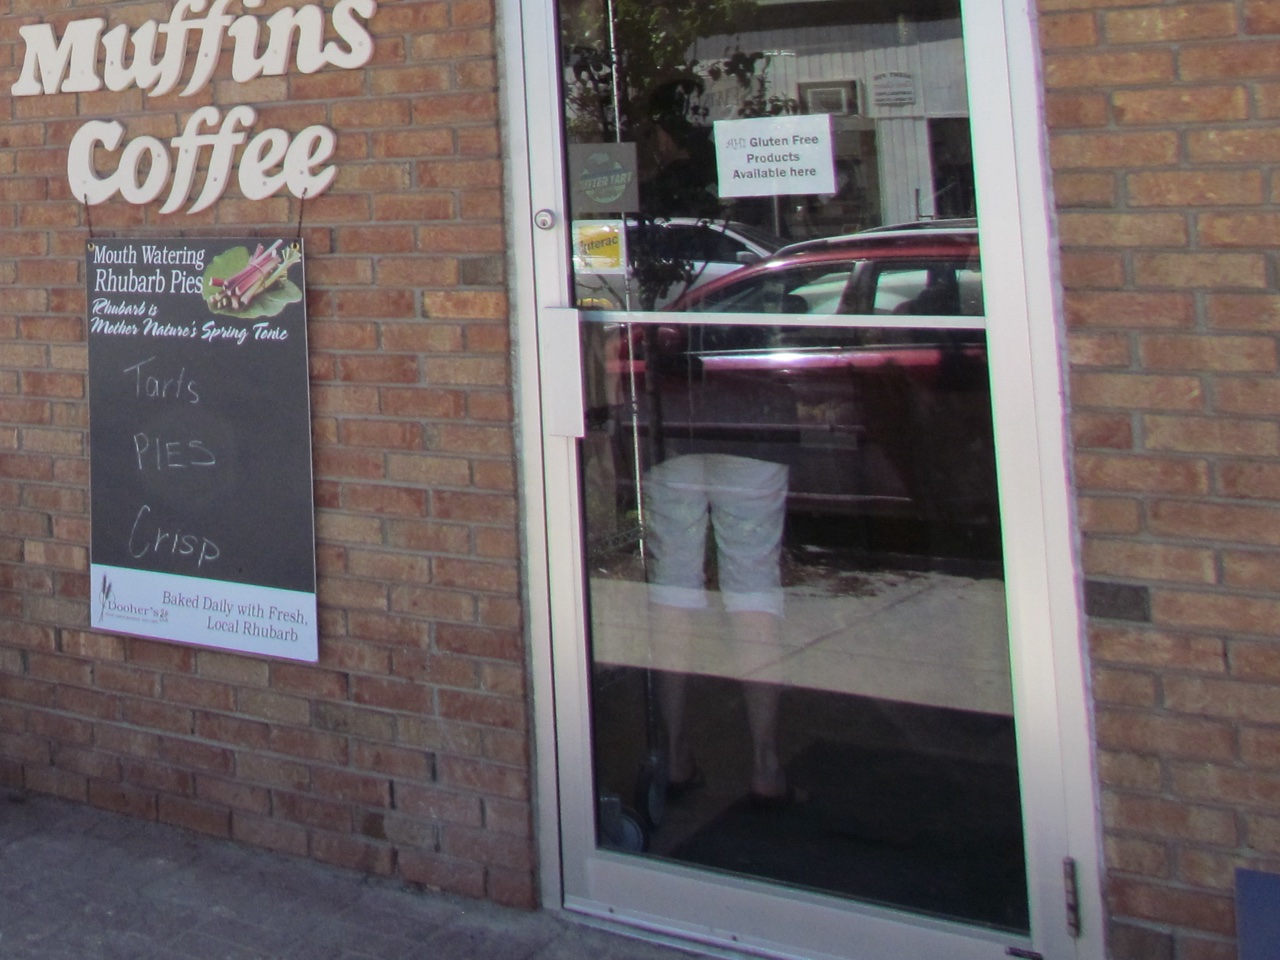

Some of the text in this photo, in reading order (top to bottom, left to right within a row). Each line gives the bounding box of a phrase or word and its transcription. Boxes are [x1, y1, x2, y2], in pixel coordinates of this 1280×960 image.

[749, 136, 789, 148] Gluten
[792, 134, 819, 145] Free
[67, 105, 339, 215] Coffee
[746, 152, 800, 163] Products
[733, 166, 817, 180] Available here
[93, 245, 205, 271] Mouth Watering
[95, 268, 204, 294] Rhubarb Pies
[92, 297, 158, 317] Rhubarb is
[90, 317, 289, 345] Mother Nature's Spring Tonic
[123, 356, 200, 404] Tarts
[133, 432, 217, 470] PIES
[128, 504, 220, 568] Crisp
[108, 601, 159, 617] Dooher's
[162, 590, 309, 627] Baked Daily with Fresh,
[207, 615, 299, 642] Local Rhubarb
